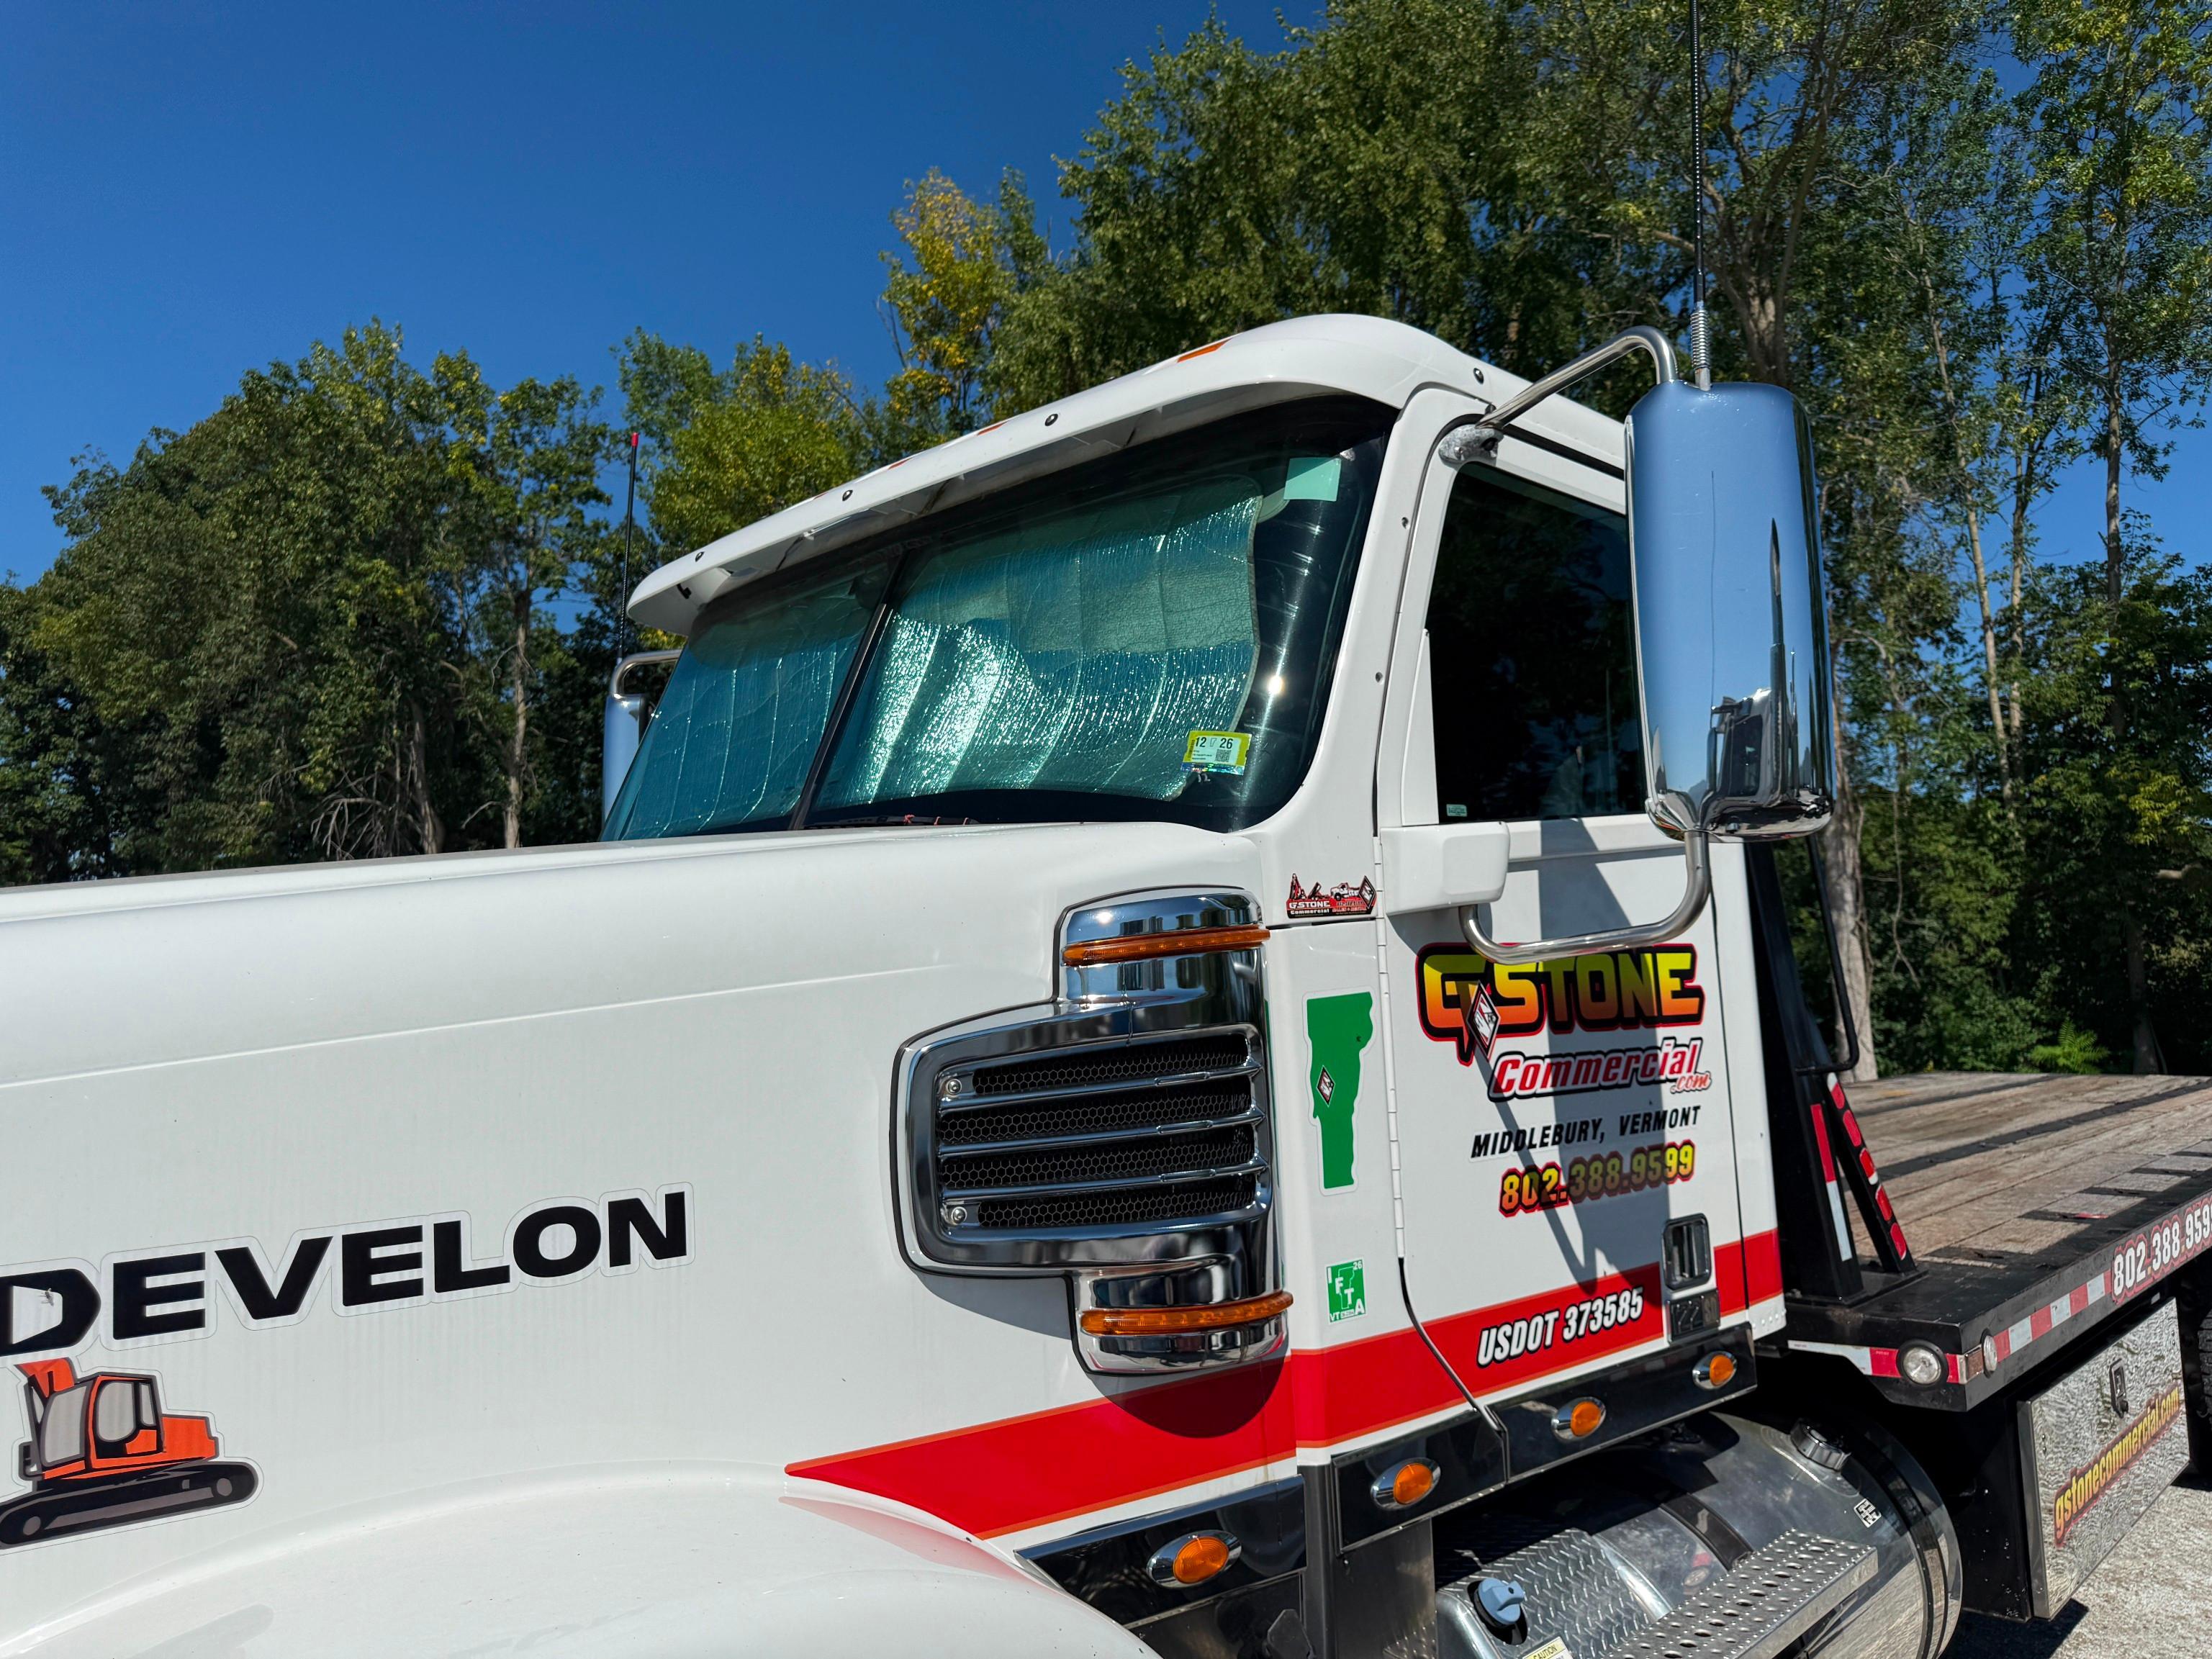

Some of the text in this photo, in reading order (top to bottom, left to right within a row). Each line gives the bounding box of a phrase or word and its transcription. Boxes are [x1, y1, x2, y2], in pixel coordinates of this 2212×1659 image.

[1196, 737, 1233, 749] 12 26
[1491, 1042, 1710, 1095] Commercial .com
[1471, 1106, 1702, 1158] MIDDLEBURY, VERMONT
[1500, 1142, 1694, 1212] 802.388.9599
[0, 1191, 687, 1357] DEVELON
[1353, 1261, 1362, 1270] 26
[2113, 1201, 2212, 1296] 802.388.959
[1330, 1312, 1340, 1321] VT
[1478, 1287, 1644, 1365] USDOT 373585
[2055, 1386, 2180, 1540] gstonecommercial.com
